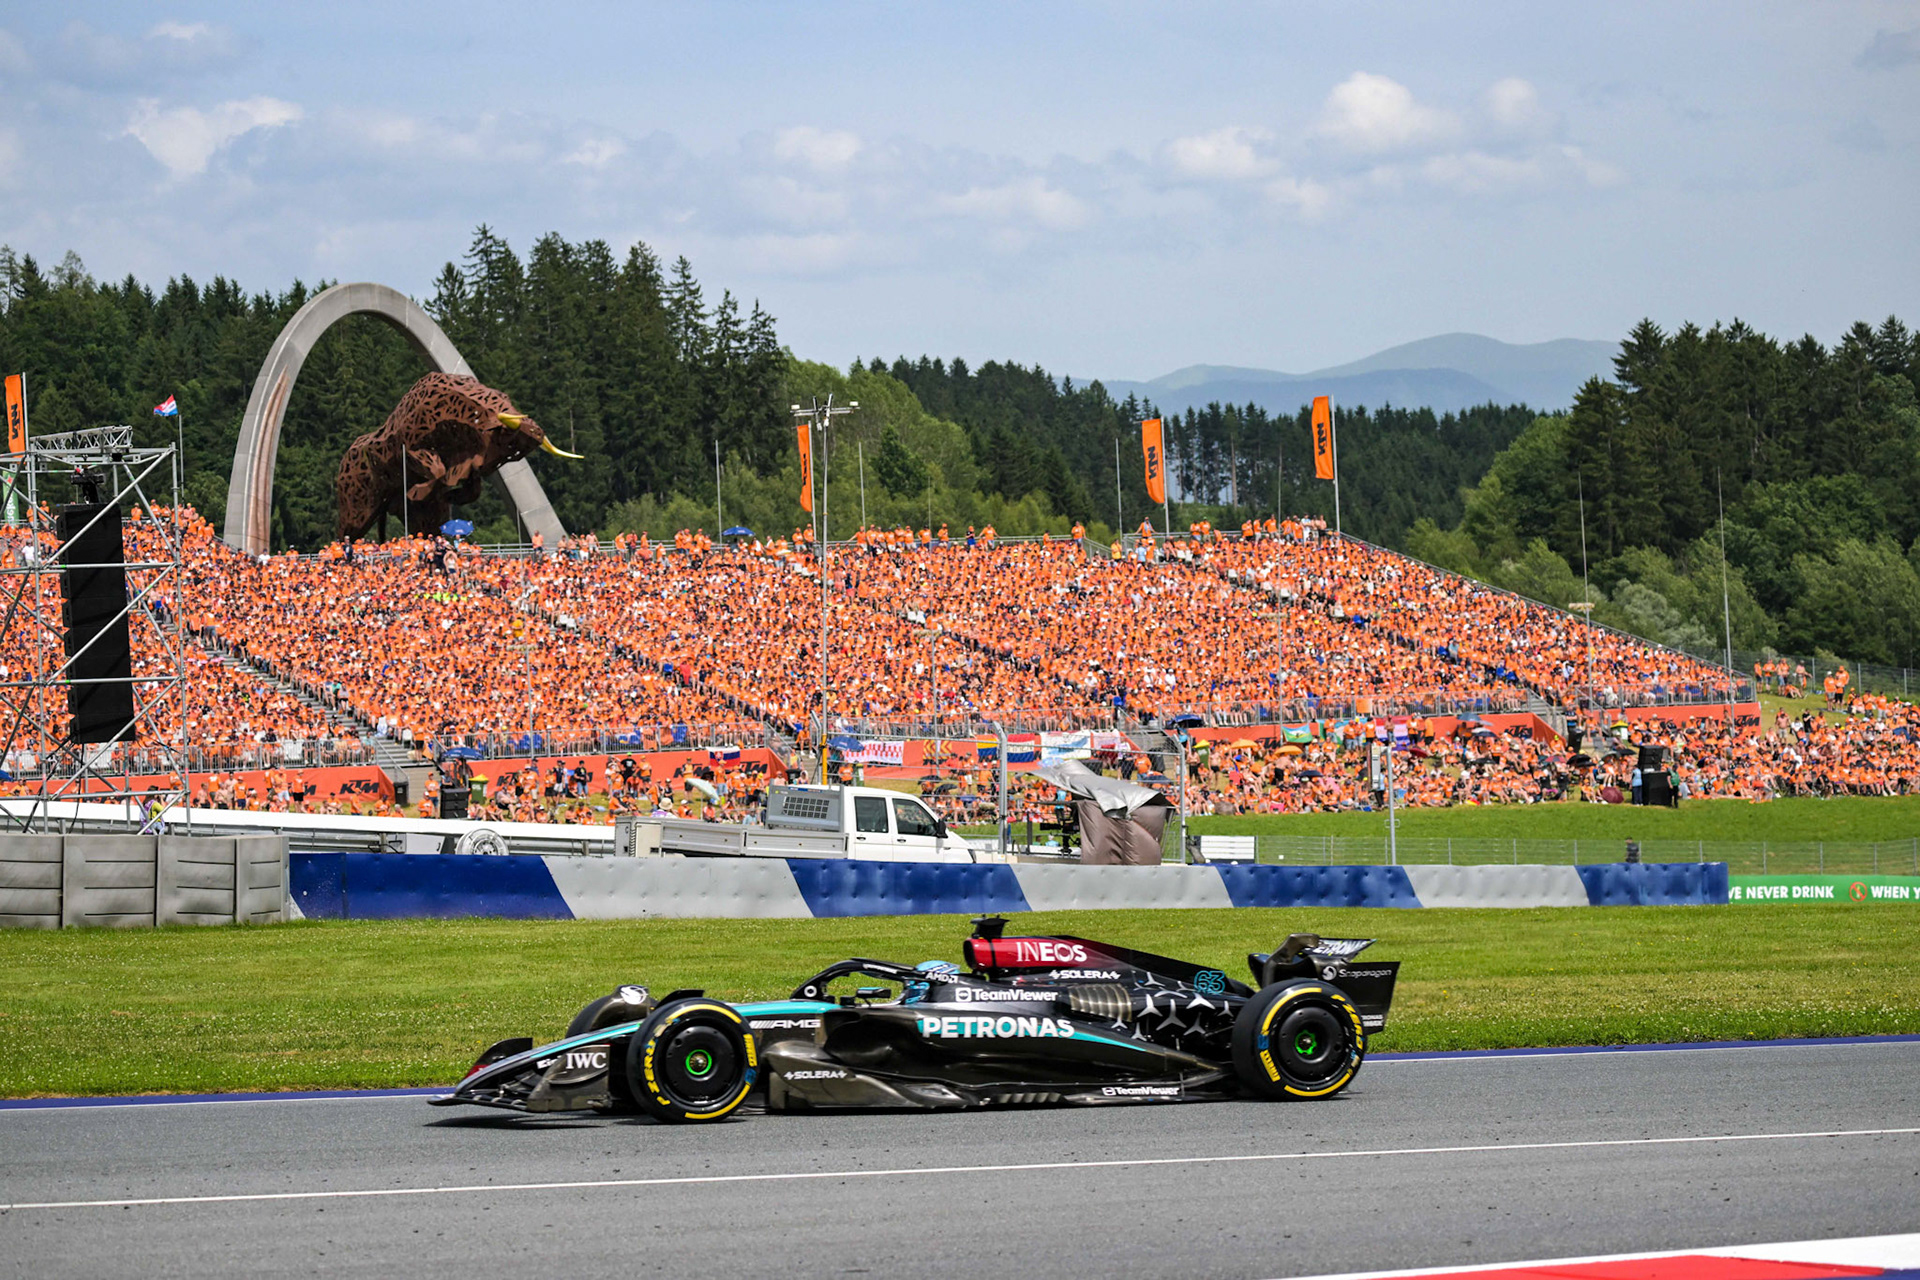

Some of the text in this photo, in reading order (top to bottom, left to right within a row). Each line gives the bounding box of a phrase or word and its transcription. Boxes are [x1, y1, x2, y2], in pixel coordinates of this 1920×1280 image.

[1746, 886, 1788, 900] NEVER
[1792, 885, 1834, 899] DRINK
[1871, 885, 1910, 899] WHEN
[1016, 941, 1088, 962] INEOS
[925, 972, 949, 982] AMD
[1060, 969, 1110, 979] SOLERA
[1193, 970, 1226, 995] 63
[972, 988, 1058, 1001] TeamViewer
[772, 1019, 821, 1029] AMG
[922, 1016, 1075, 1039] PETRONAS
[566, 1052, 607, 1070] IWC
[794, 1070, 839, 1080] SOLERA
[1114, 1086, 1180, 1096] TeamViewer
